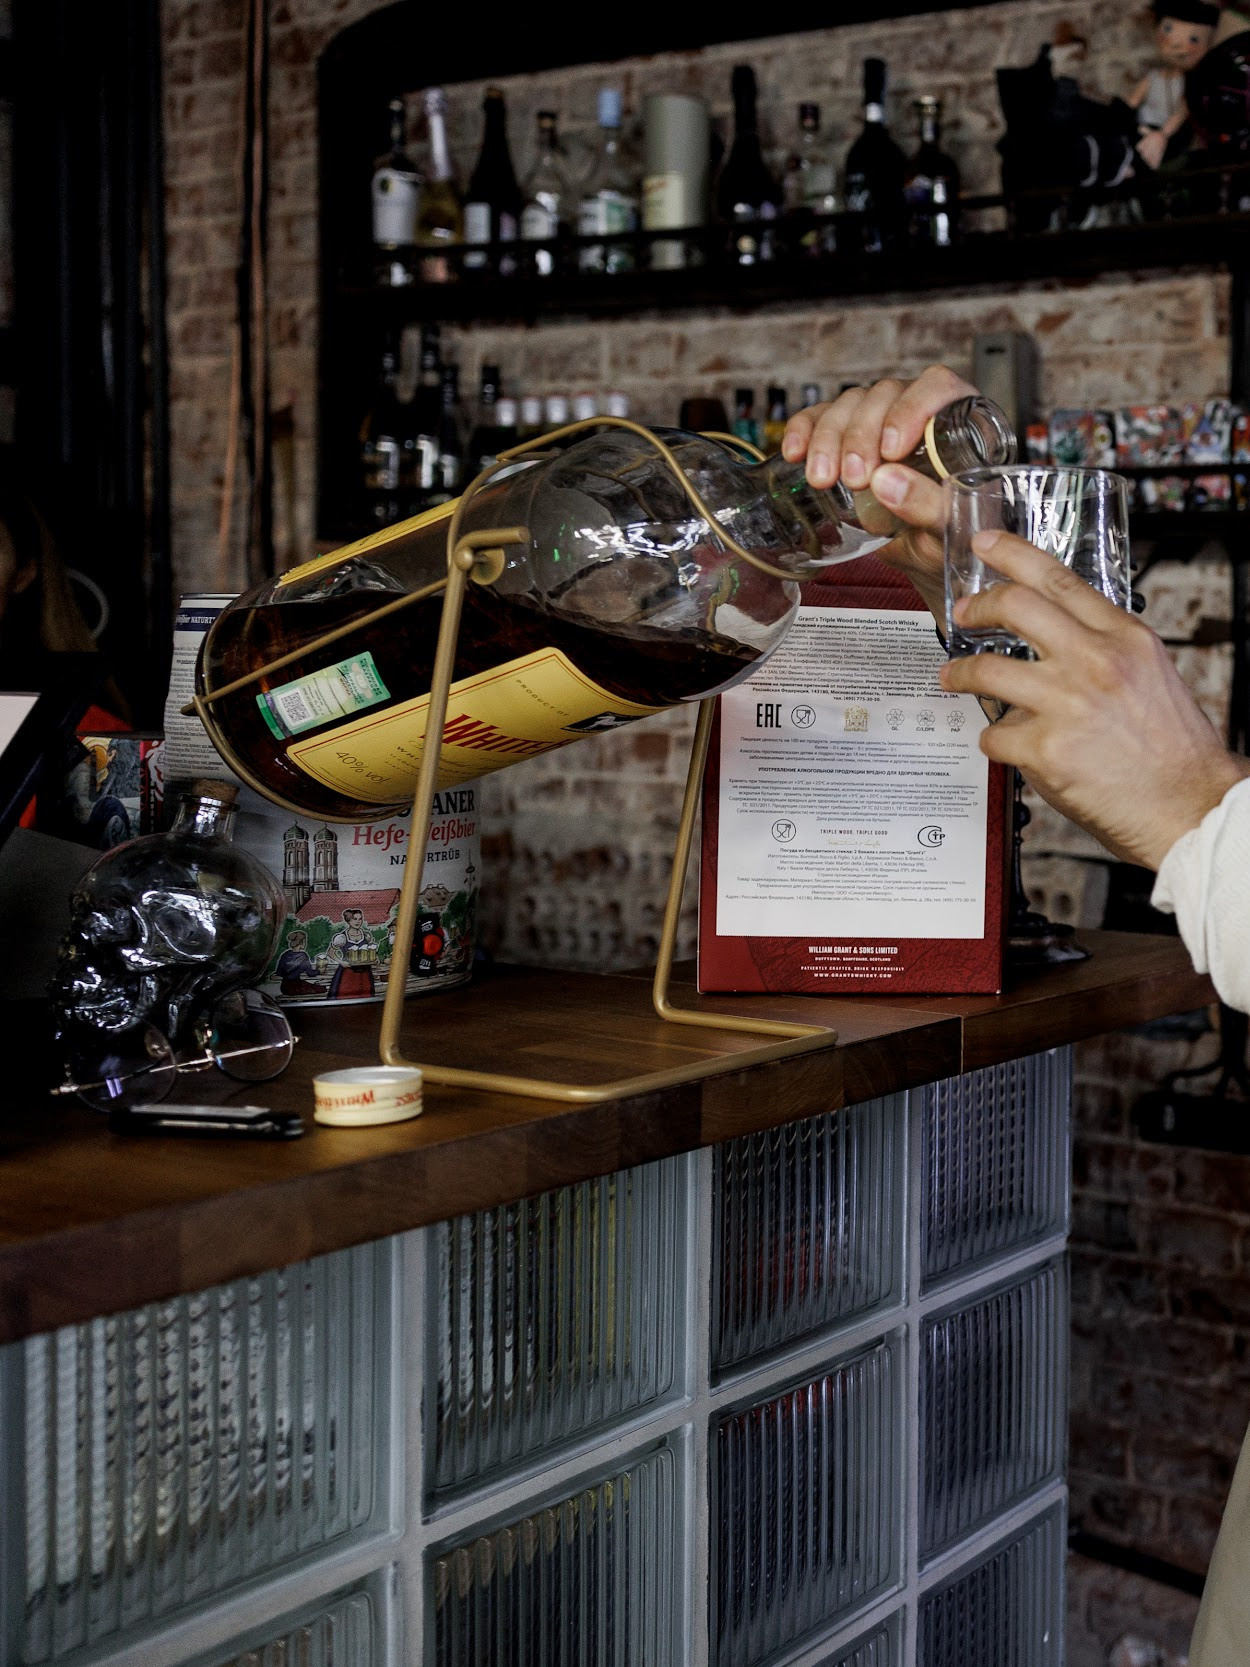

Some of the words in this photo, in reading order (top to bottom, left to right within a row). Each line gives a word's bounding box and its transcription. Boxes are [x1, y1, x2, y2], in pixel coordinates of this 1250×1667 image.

[516, 679, 555, 709] PRODUCT
[418, 713, 553, 754] WHITE
[336, 752, 369, 773] 40%
[365, 772, 392, 784] vol
[389, 849, 460, 866] NARTRÜB
